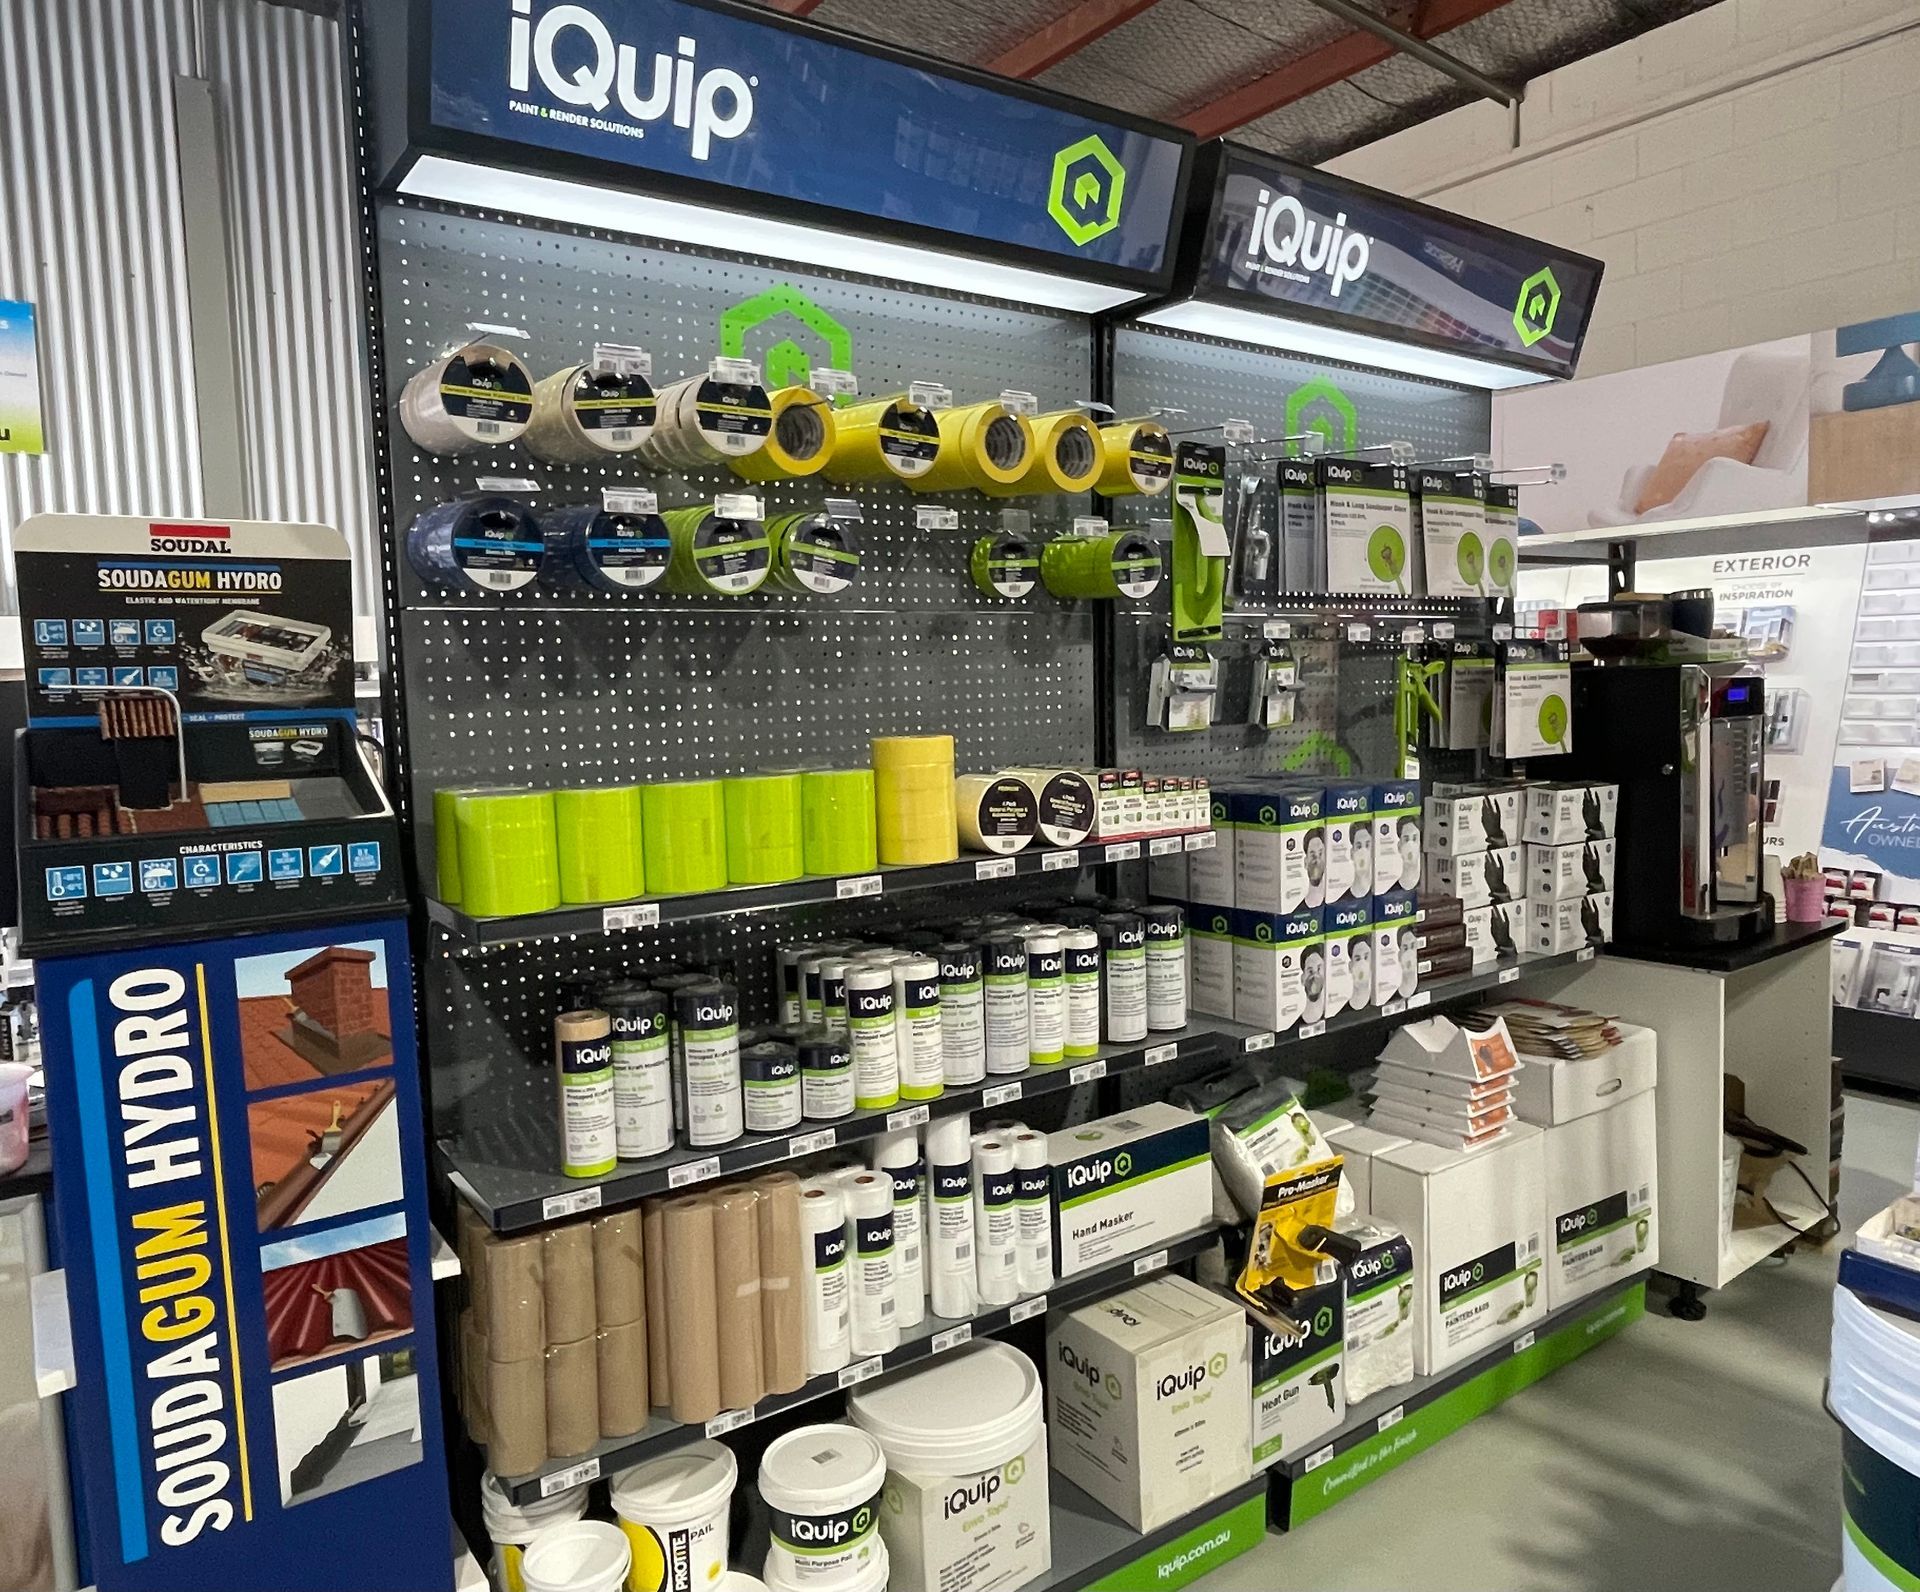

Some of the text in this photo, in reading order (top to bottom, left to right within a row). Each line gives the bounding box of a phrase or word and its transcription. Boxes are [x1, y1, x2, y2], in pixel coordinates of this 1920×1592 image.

[510, 0, 754, 160] iQuip
[509, 101, 644, 139] PAINT & RENDER SOLUTIONS
[1248, 189, 1370, 297] iQuip
[1183, 457, 1208, 473] iQuip
[1285, 468, 1307, 483] iQuip
[1328, 466, 1352, 481] iQuip
[1423, 476, 1443, 490] iQuip
[485, 530, 504, 540] iQuip
[150, 538, 231, 554] SOUDAL
[1713, 554, 1811, 573] EXTERIOR
[98, 569, 282, 590] SOUDAGUM HYDRO
[1719, 589, 1793, 601] INSPIRATION
[1507, 646, 1527, 658] iQuip
[249, 727, 328, 738] SOUDAGUM HYDRO
[1337, 797, 1359, 810] iQuip
[1384, 792, 1405, 805] iQuip
[1290, 804, 1311, 817] iQuip
[179, 840, 264, 855] CHARACTERISTICS
[1384, 902, 1404, 915] iQuip
[1336, 911, 1357, 925] iQuip
[1147, 922, 1177, 936] iQuip
[1286, 921, 1309, 935] iQuip
[1119, 931, 1144, 944] iQuip
[996, 954, 1026, 968] iQuip
[941, 963, 975, 978] iQuip
[859, 994, 892, 1010] iQuip
[696, 1005, 733, 1022] iQuip
[612, 1016, 651, 1035] iQuip
[576, 1045, 611, 1064] iQuip
[109, 966, 203, 1189] HYDRO
[771, 1064, 794, 1075] iQuip
[942, 1176, 968, 1188] iQuip
[1067, 1159, 1112, 1190] iQuip
[894, 1178, 916, 1191] Quip
[1021, 1179, 1046, 1192] iQuip
[1072, 1210, 1135, 1241] Hand Masker
[1560, 1213, 1586, 1234] iQuip
[867, 1228, 892, 1243] iQuip
[1350, 1258, 1382, 1280] iQuip
[1443, 1269, 1471, 1293] iQuip
[1445, 1302, 1490, 1329] PAINTERS RAGS
[1058, 1341, 1100, 1387] iQuip
[131, 1200, 234, 1547] SOUDAGUM
[1156, 1364, 1206, 1401] iQuip
[1261, 1385, 1300, 1413] Heat Gun
[944, 1474, 1001, 1521] iQuip
[690, 1523, 714, 1541] PAIL
[790, 1519, 849, 1544] iQuip
[794, 1553, 853, 1568] Multi Purpose Pail
[1157, 1529, 1231, 1579] iquip.com.au
